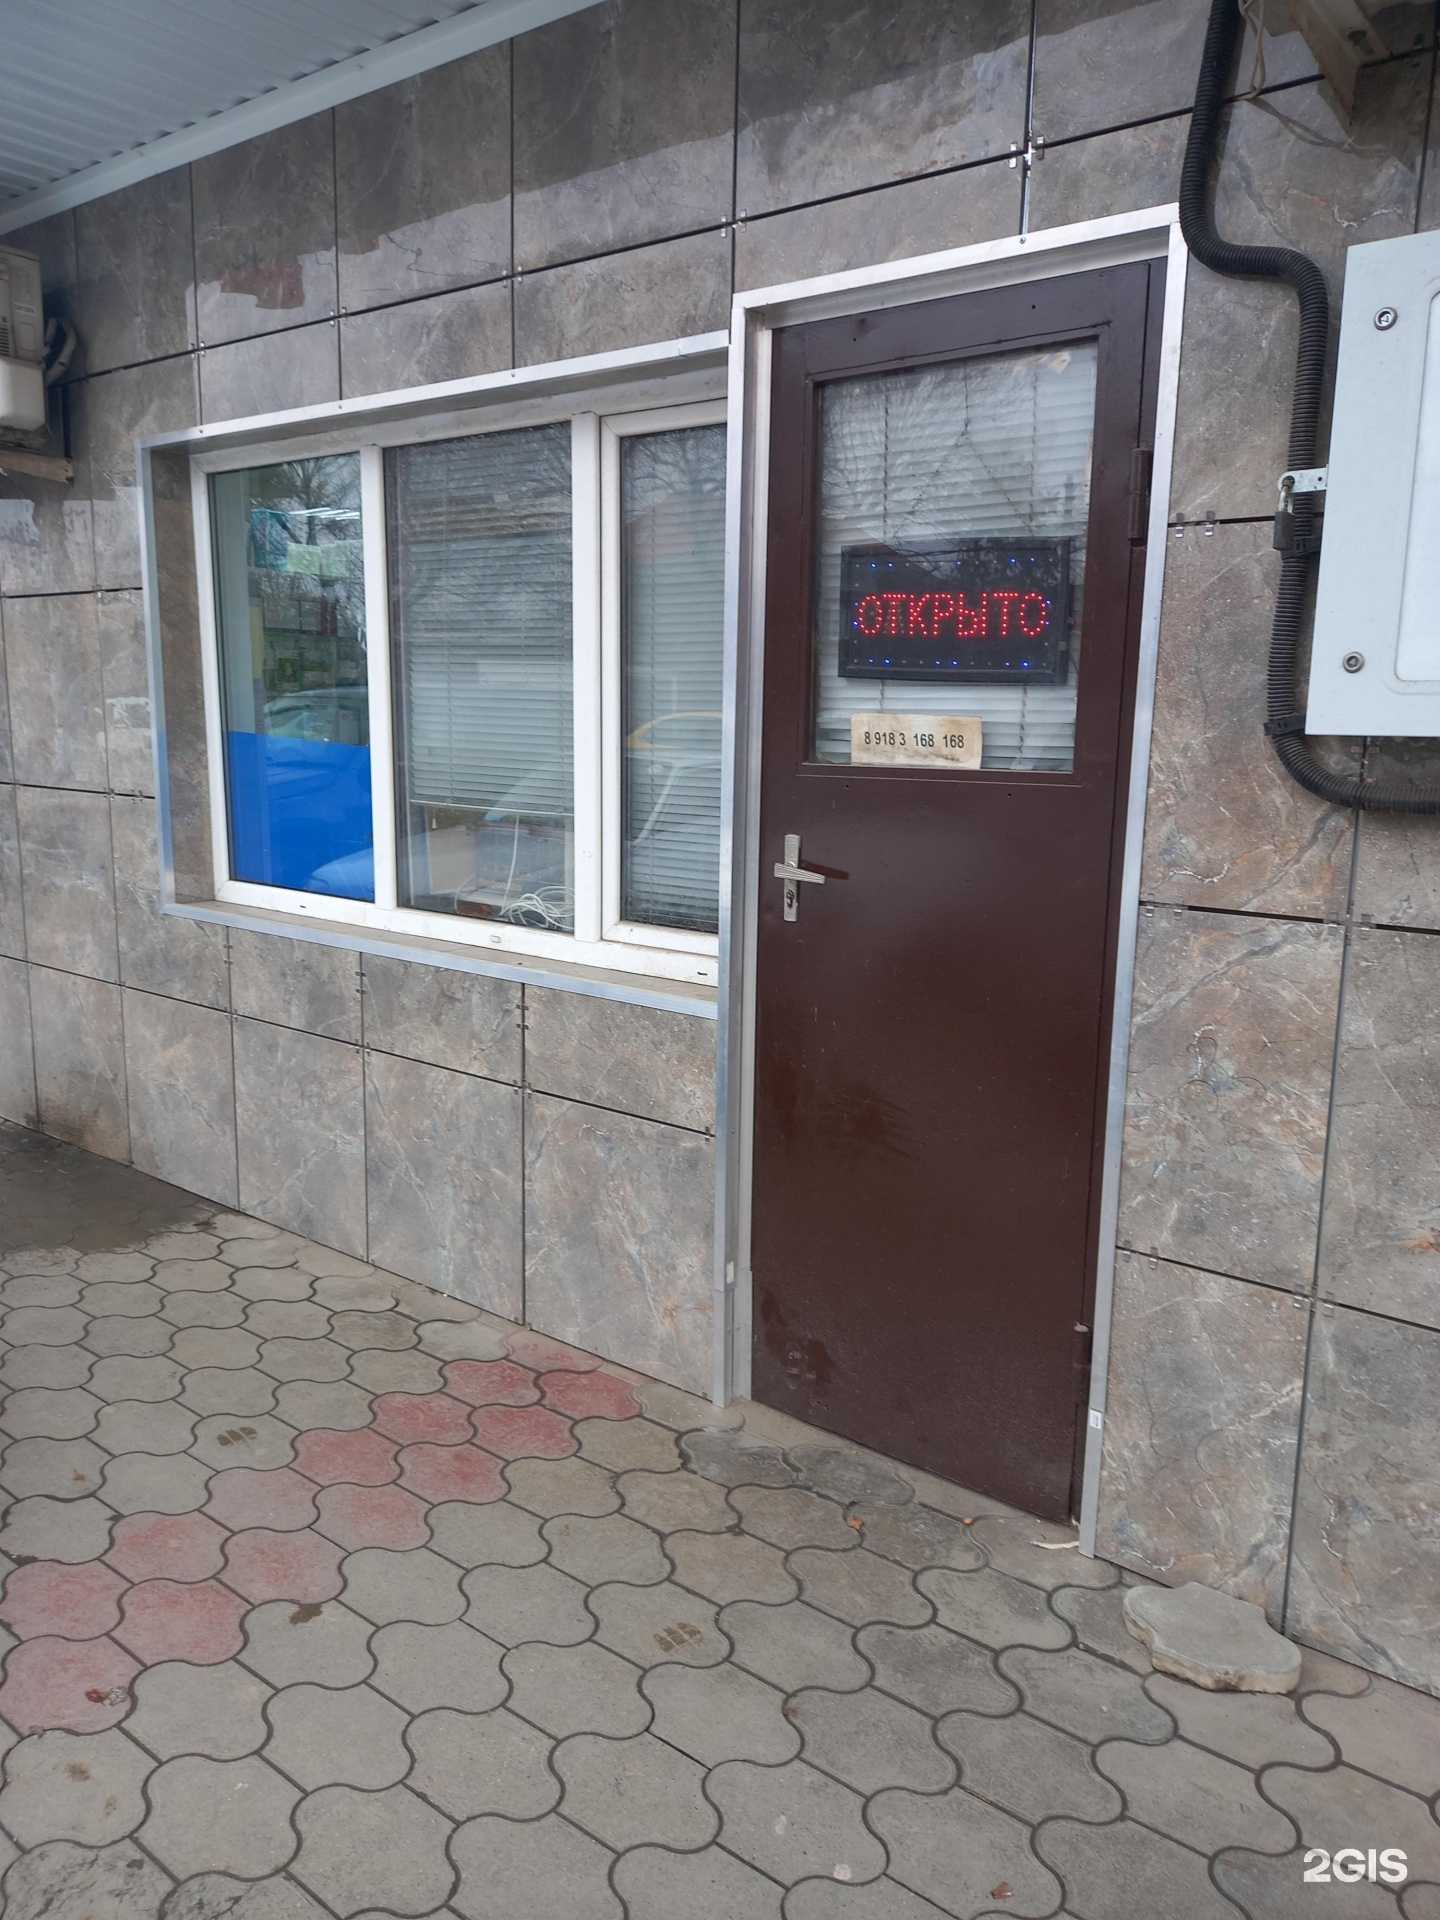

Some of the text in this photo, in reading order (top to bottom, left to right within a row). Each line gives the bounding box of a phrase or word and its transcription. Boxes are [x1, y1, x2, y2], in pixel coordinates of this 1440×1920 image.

[856, 591, 1048, 637] ОТКРЫТО
[913, 733, 935, 747] 168
[943, 734, 965, 748] 168
